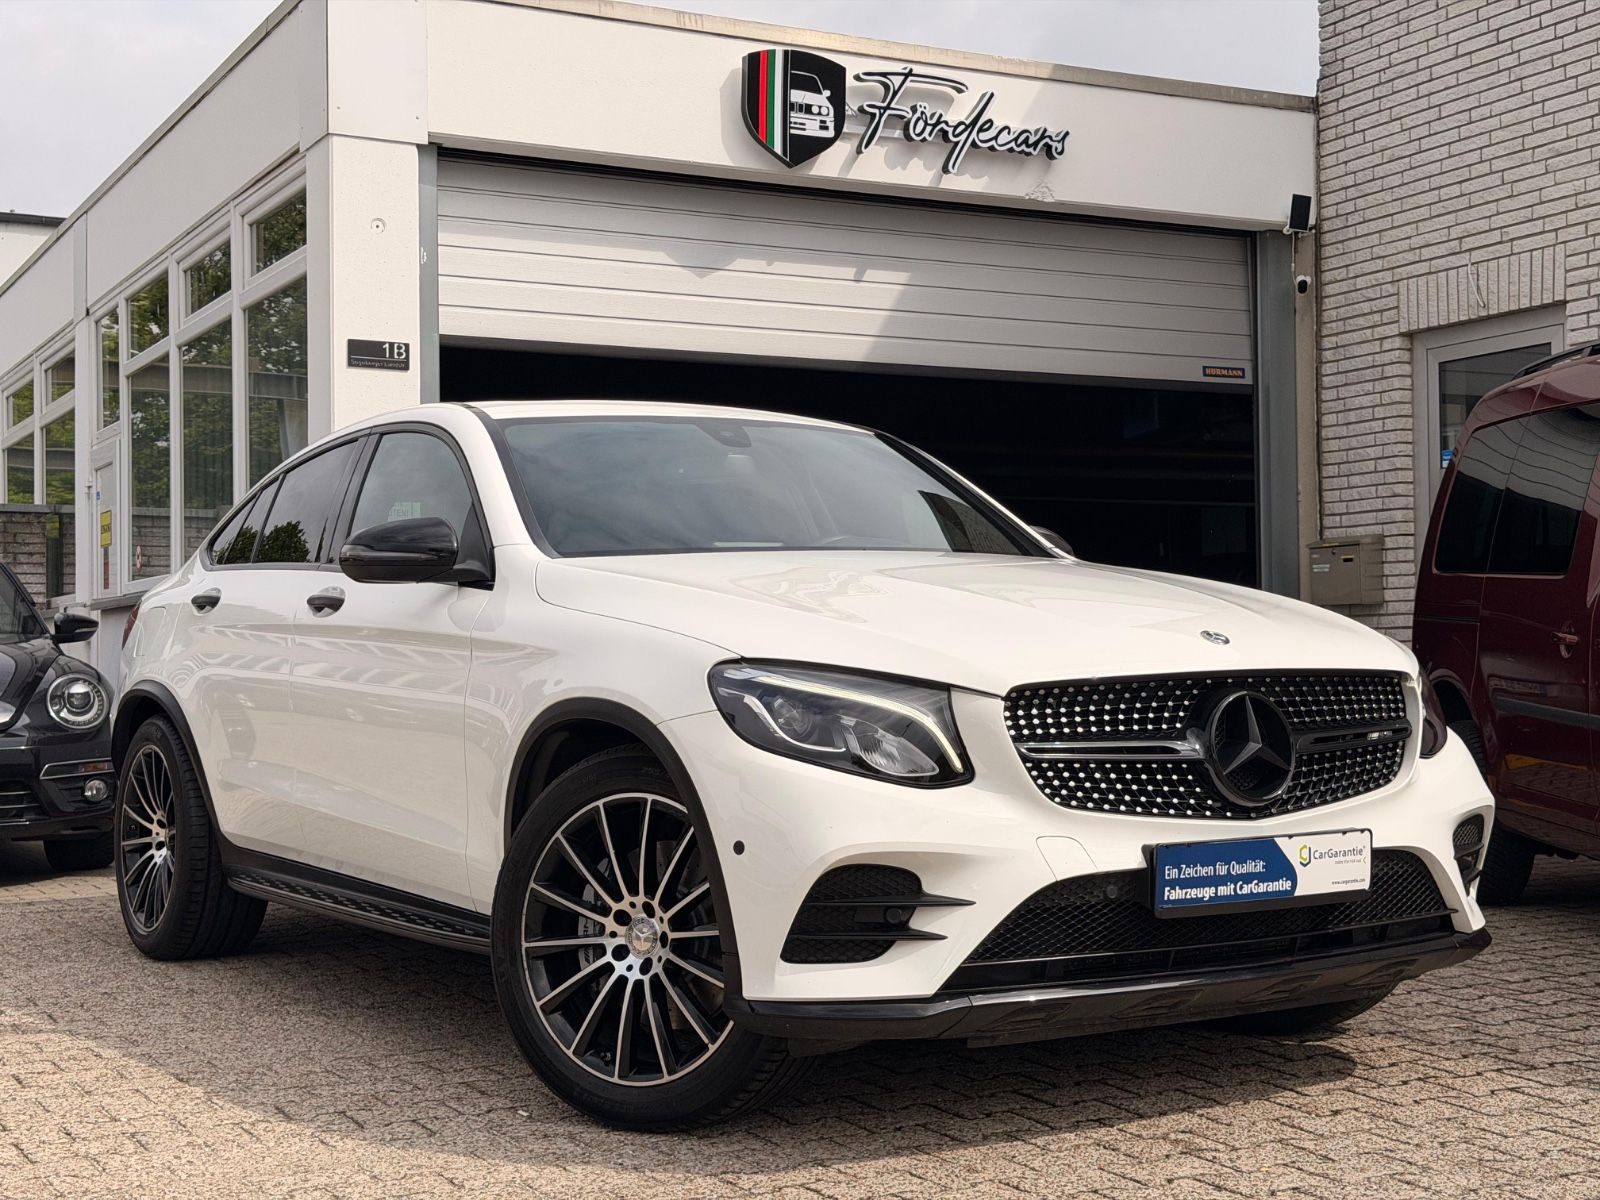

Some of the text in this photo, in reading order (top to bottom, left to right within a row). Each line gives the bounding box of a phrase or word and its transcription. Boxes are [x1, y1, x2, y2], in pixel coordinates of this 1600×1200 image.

[853, 67, 1070, 175] Fördecars
[382, 343, 406, 359] 1B
[1313, 846, 1363, 860] CarGarantie
[1165, 859, 1266, 880] Ein Zeichen für Qualität:
[1164, 877, 1292, 901] Fahrzeuge mit CarGarantie
